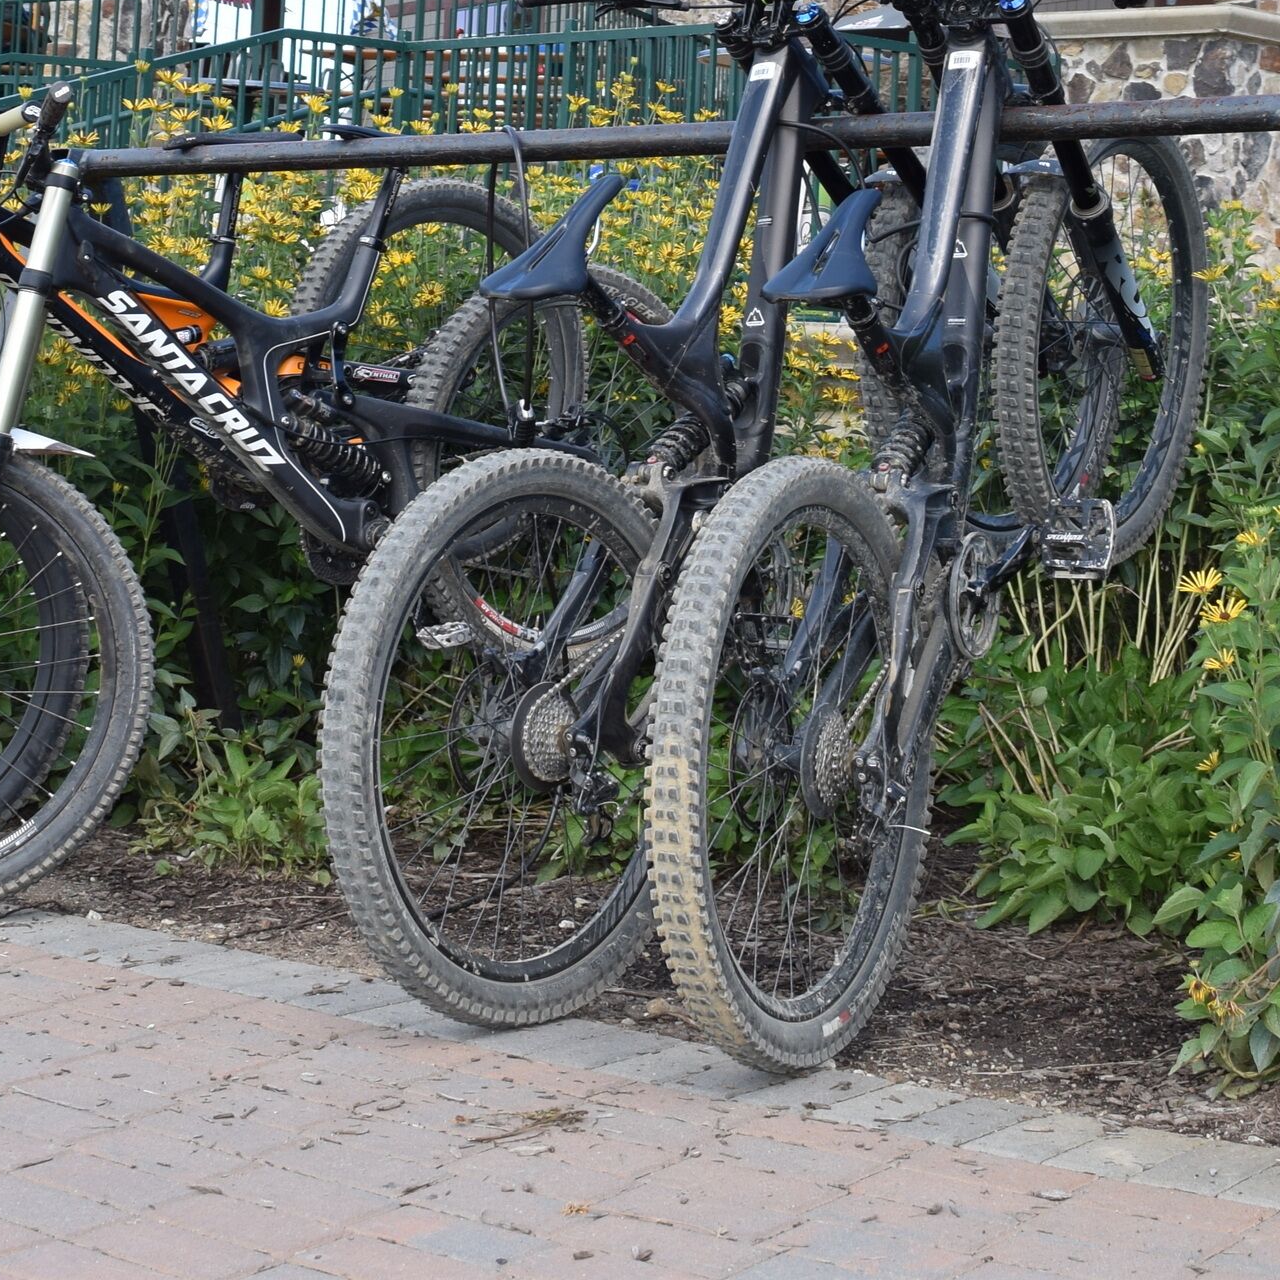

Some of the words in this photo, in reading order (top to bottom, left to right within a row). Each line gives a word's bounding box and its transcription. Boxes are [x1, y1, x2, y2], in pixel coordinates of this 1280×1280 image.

[598, 282, 657, 320] TRAGER
[96, 290, 209, 396] SANTA
[197, 392, 287, 472] CRUZ
